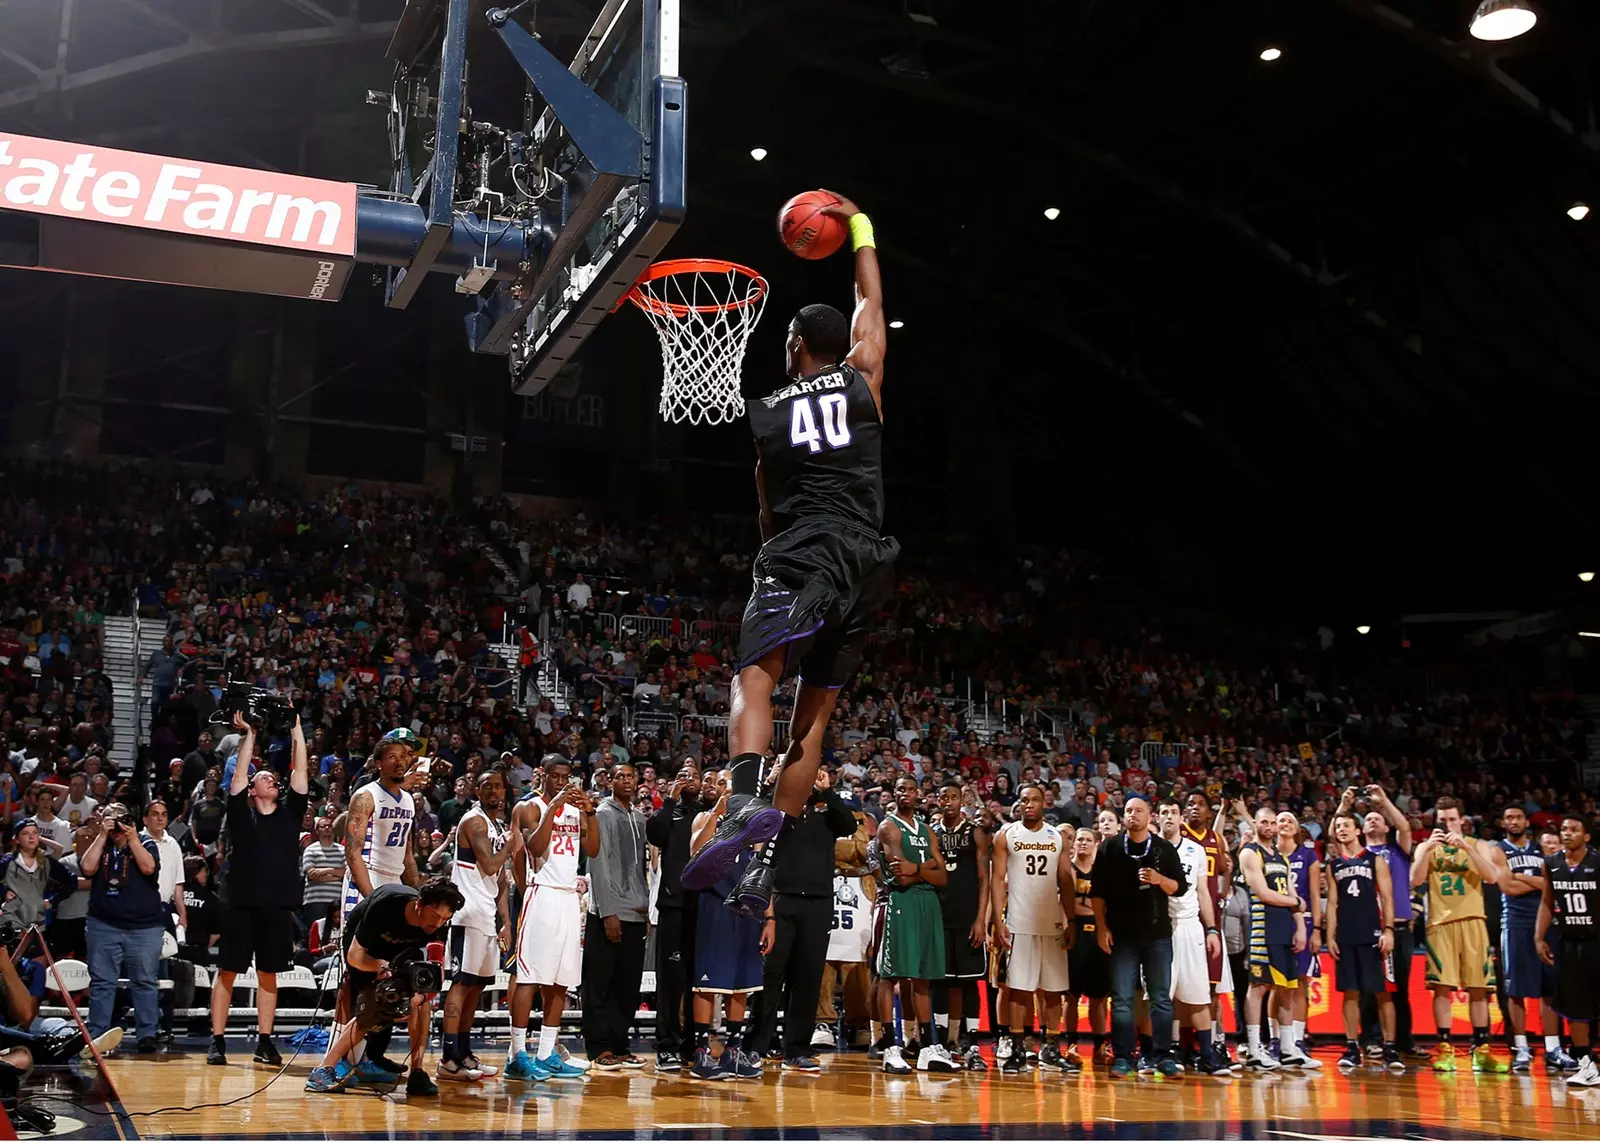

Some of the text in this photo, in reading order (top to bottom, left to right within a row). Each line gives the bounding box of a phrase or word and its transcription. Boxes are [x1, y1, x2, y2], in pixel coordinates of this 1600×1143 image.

[788, 391, 851, 455] 40
[386, 821, 410, 847] 21
[552, 835, 575, 856] 24
[1013, 841, 1057, 852] Shockers
[1025, 855, 1048, 876] 32
[1347, 879, 1360, 897] 4
[1440, 875, 1465, 896] 24
[1552, 881, 1597, 890] TARLETON
[1564, 893, 1587, 913] 10
[1565, 916, 1593, 925] STATE
